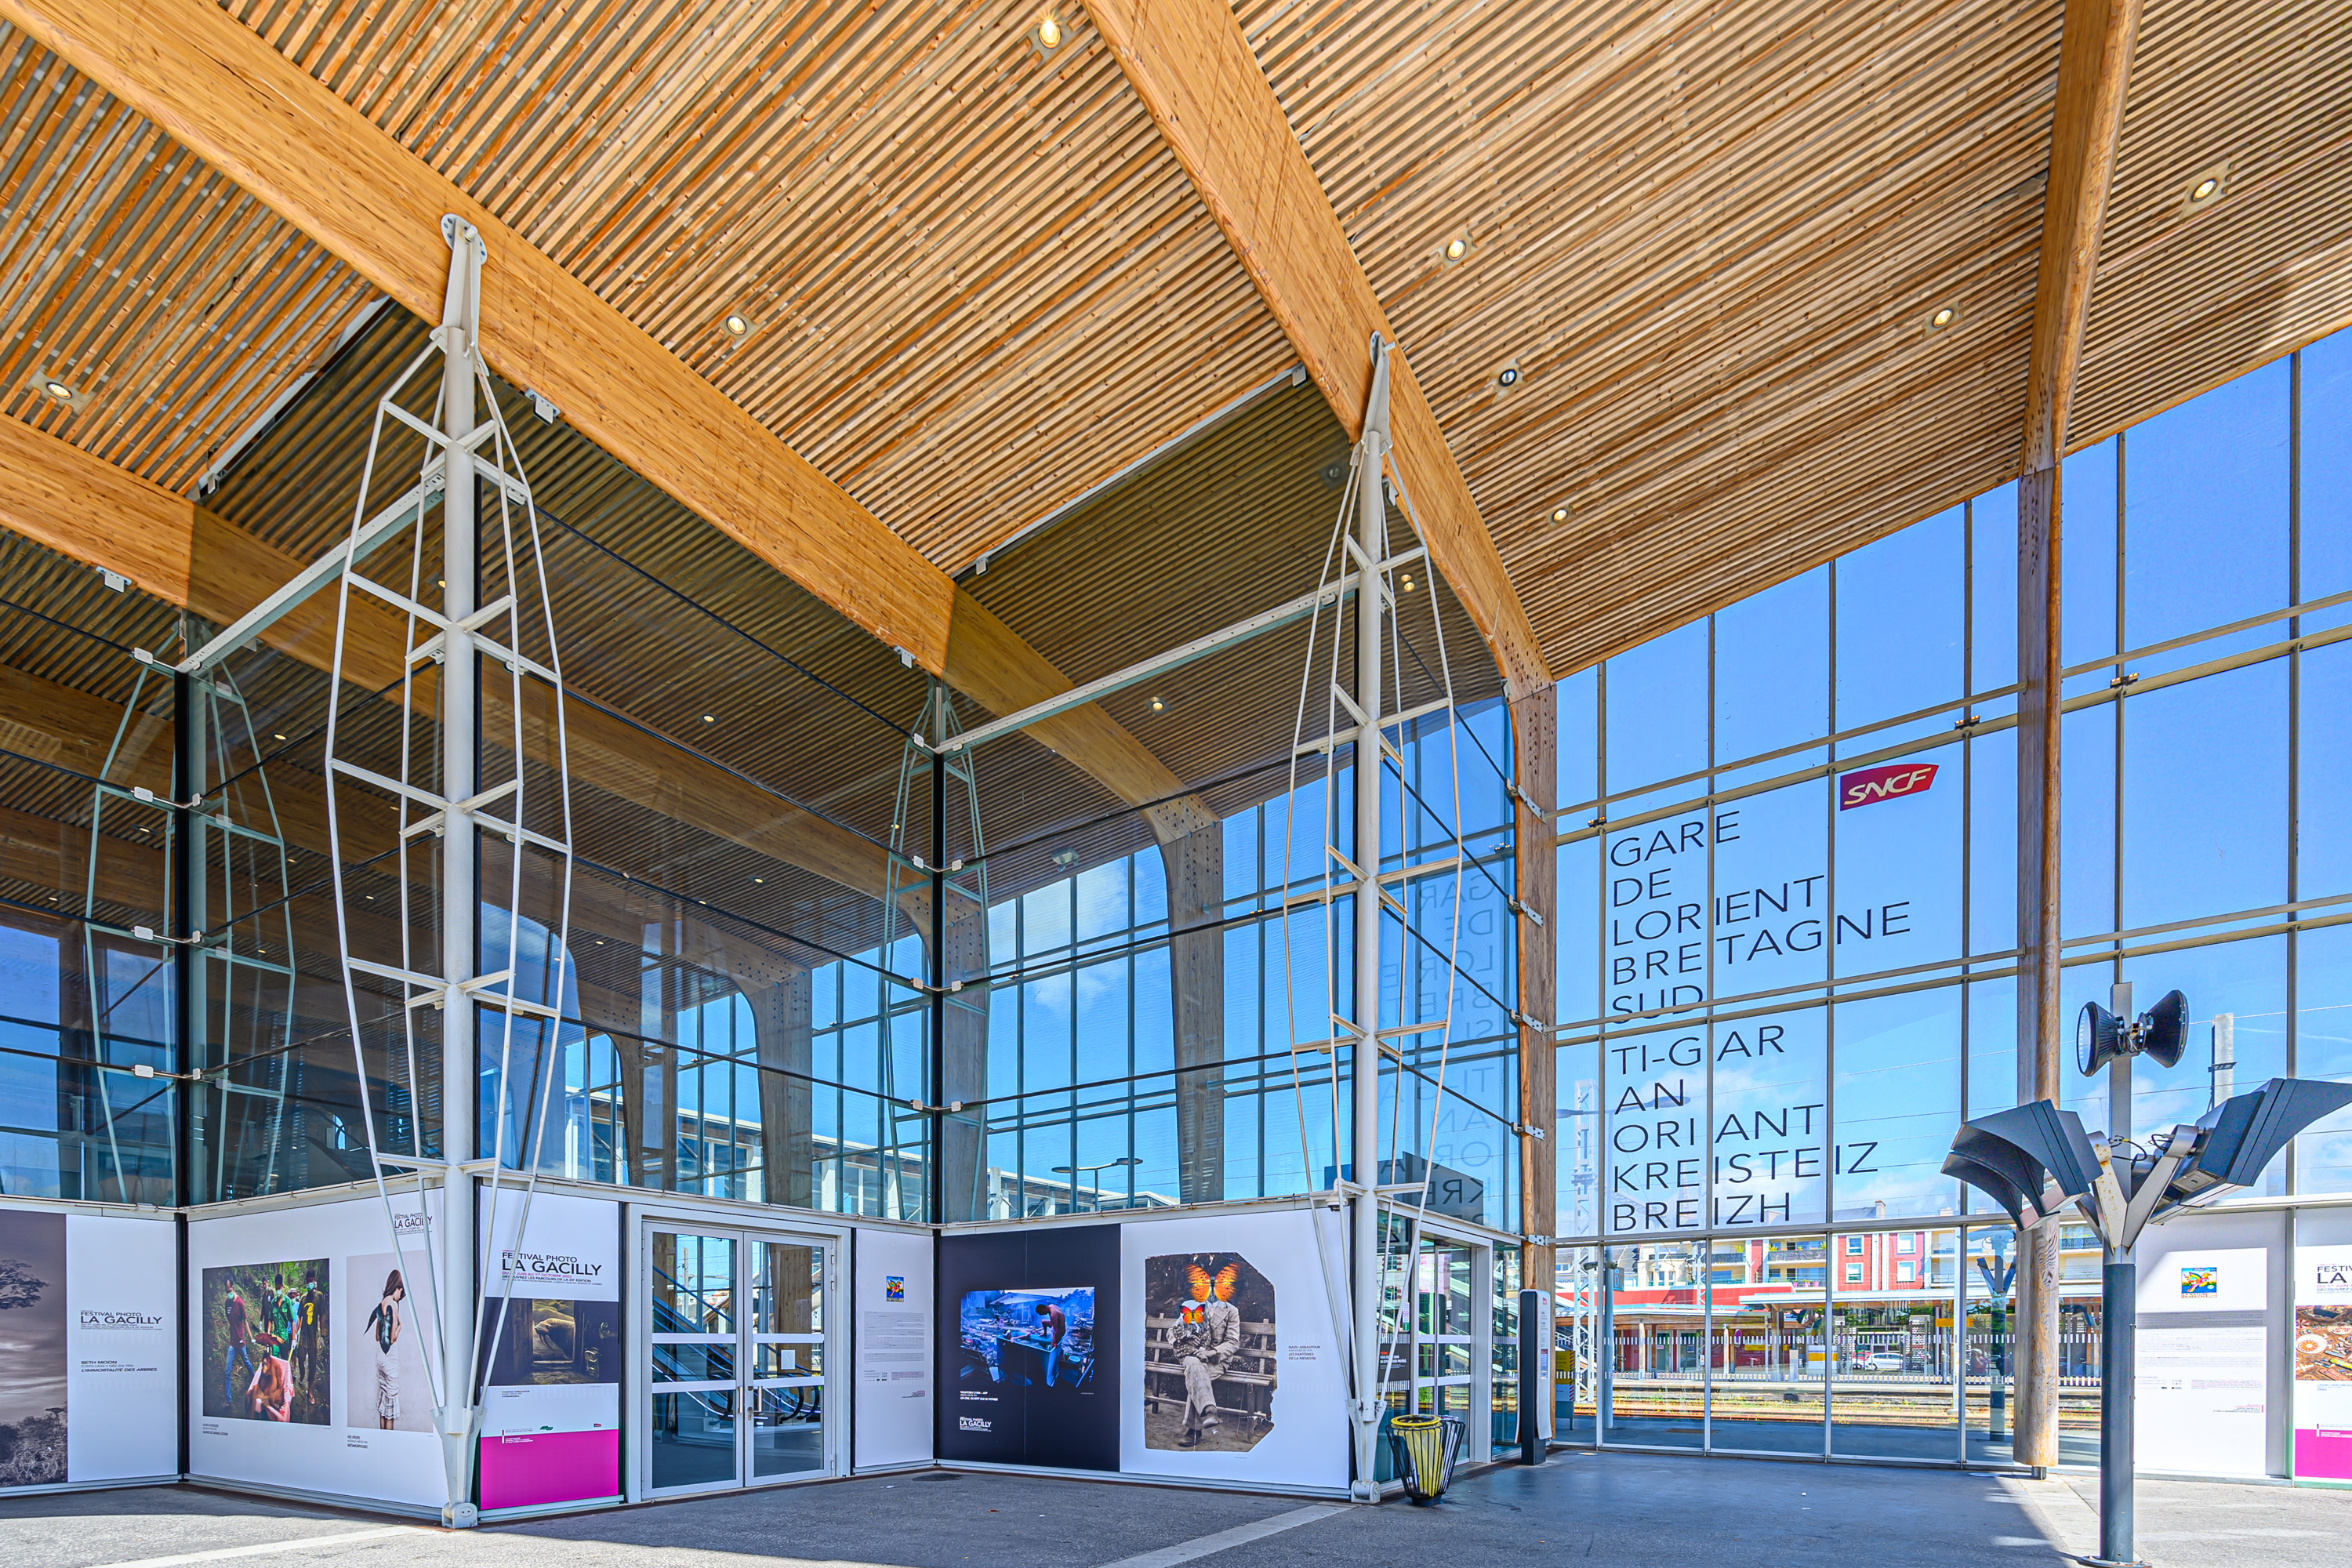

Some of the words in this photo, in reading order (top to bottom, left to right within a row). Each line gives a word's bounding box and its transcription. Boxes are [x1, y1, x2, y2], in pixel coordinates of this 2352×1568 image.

[1843, 767, 1932, 806] SNCF
[1610, 811, 1740, 867] GARE
[1613, 868, 1672, 907] DE
[1613, 875, 1825, 946] LORIENT
[1613, 901, 1911, 985] BRETAGNE
[1612, 985, 1704, 1024] SUD
[1611, 1025, 1785, 1075] TI-GAR
[1614, 1079, 1684, 1115] AN
[1613, 1104, 1824, 1152] ORIANT
[1614, 1142, 1878, 1193] KREISTEIZ
[394, 1219, 403, 1229] LA
[405, 1216, 433, 1228] GACILY
[1614, 1192, 1790, 1232] BREIZH
[502, 1251, 544, 1261] FETIVAL
[546, 1254, 578, 1263] PHOTO
[502, 1258, 526, 1272] LA
[532, 1261, 603, 1276] GACILLY
[2317, 1272, 2347, 1284] LA
